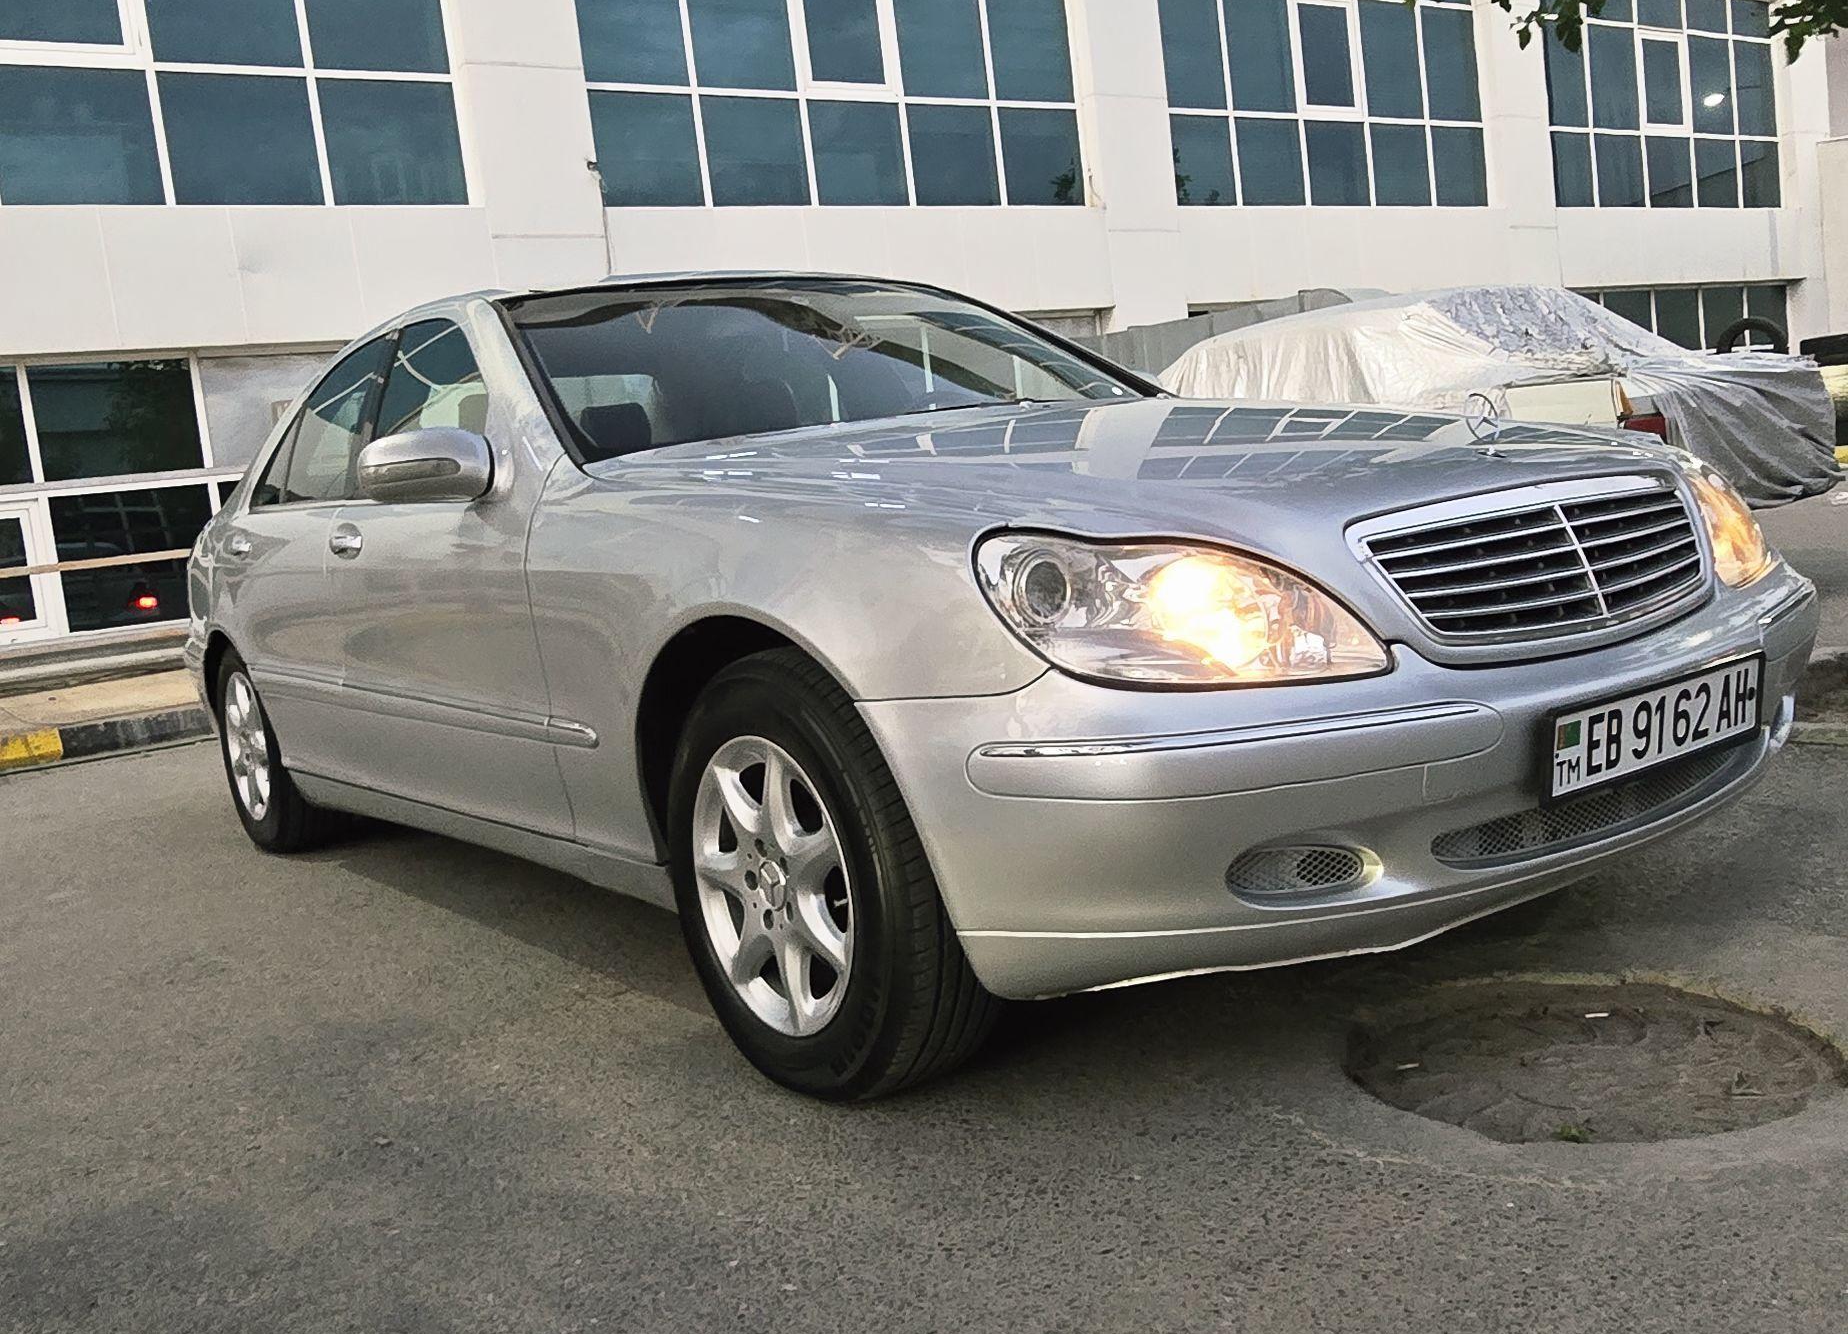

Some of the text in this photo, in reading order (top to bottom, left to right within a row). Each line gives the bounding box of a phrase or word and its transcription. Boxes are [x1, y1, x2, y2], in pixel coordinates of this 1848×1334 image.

[1586, 668, 1749, 777] EB 9162 AH
[1556, 756, 1581, 787] TM
